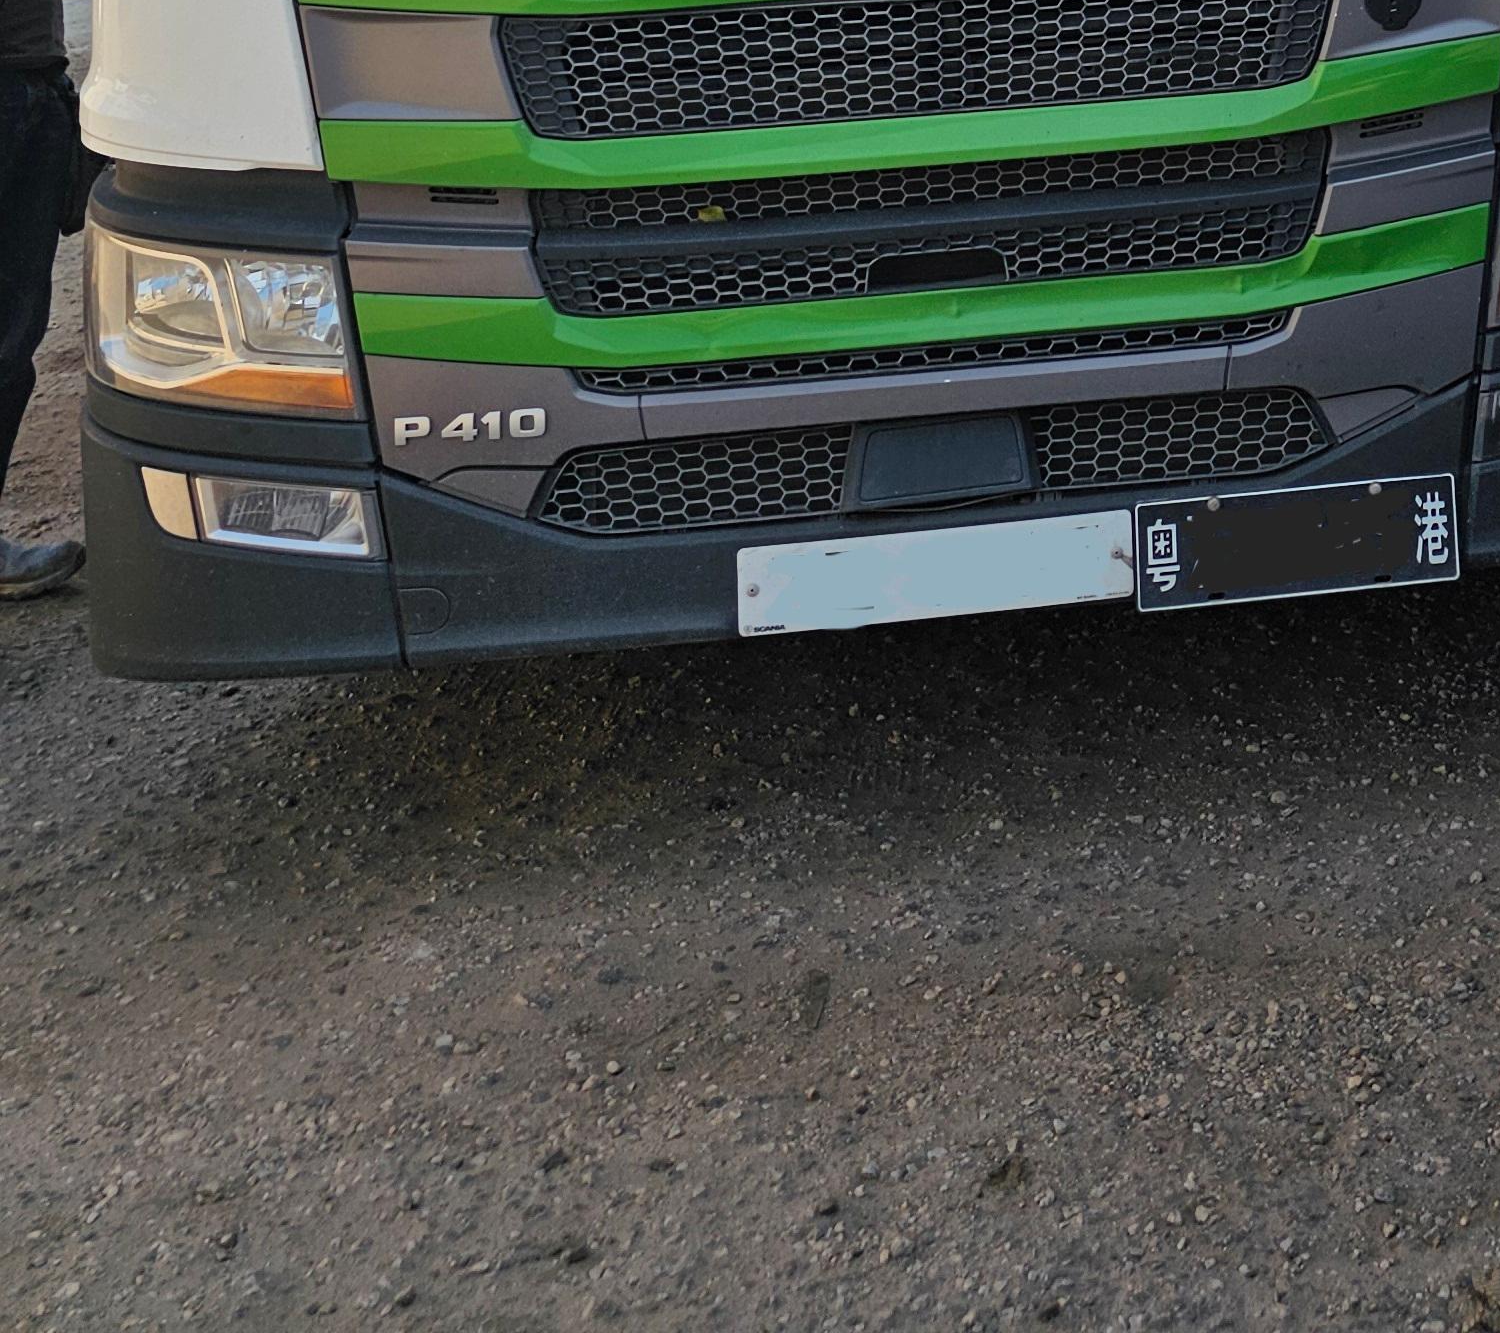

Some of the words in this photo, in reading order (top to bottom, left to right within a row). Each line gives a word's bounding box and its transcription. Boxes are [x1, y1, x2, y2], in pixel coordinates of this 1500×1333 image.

[394, 416, 431, 447] P
[441, 407, 546, 443] 410
[1145, 518, 1181, 593] 粤
[1414, 490, 1450, 565] 港
